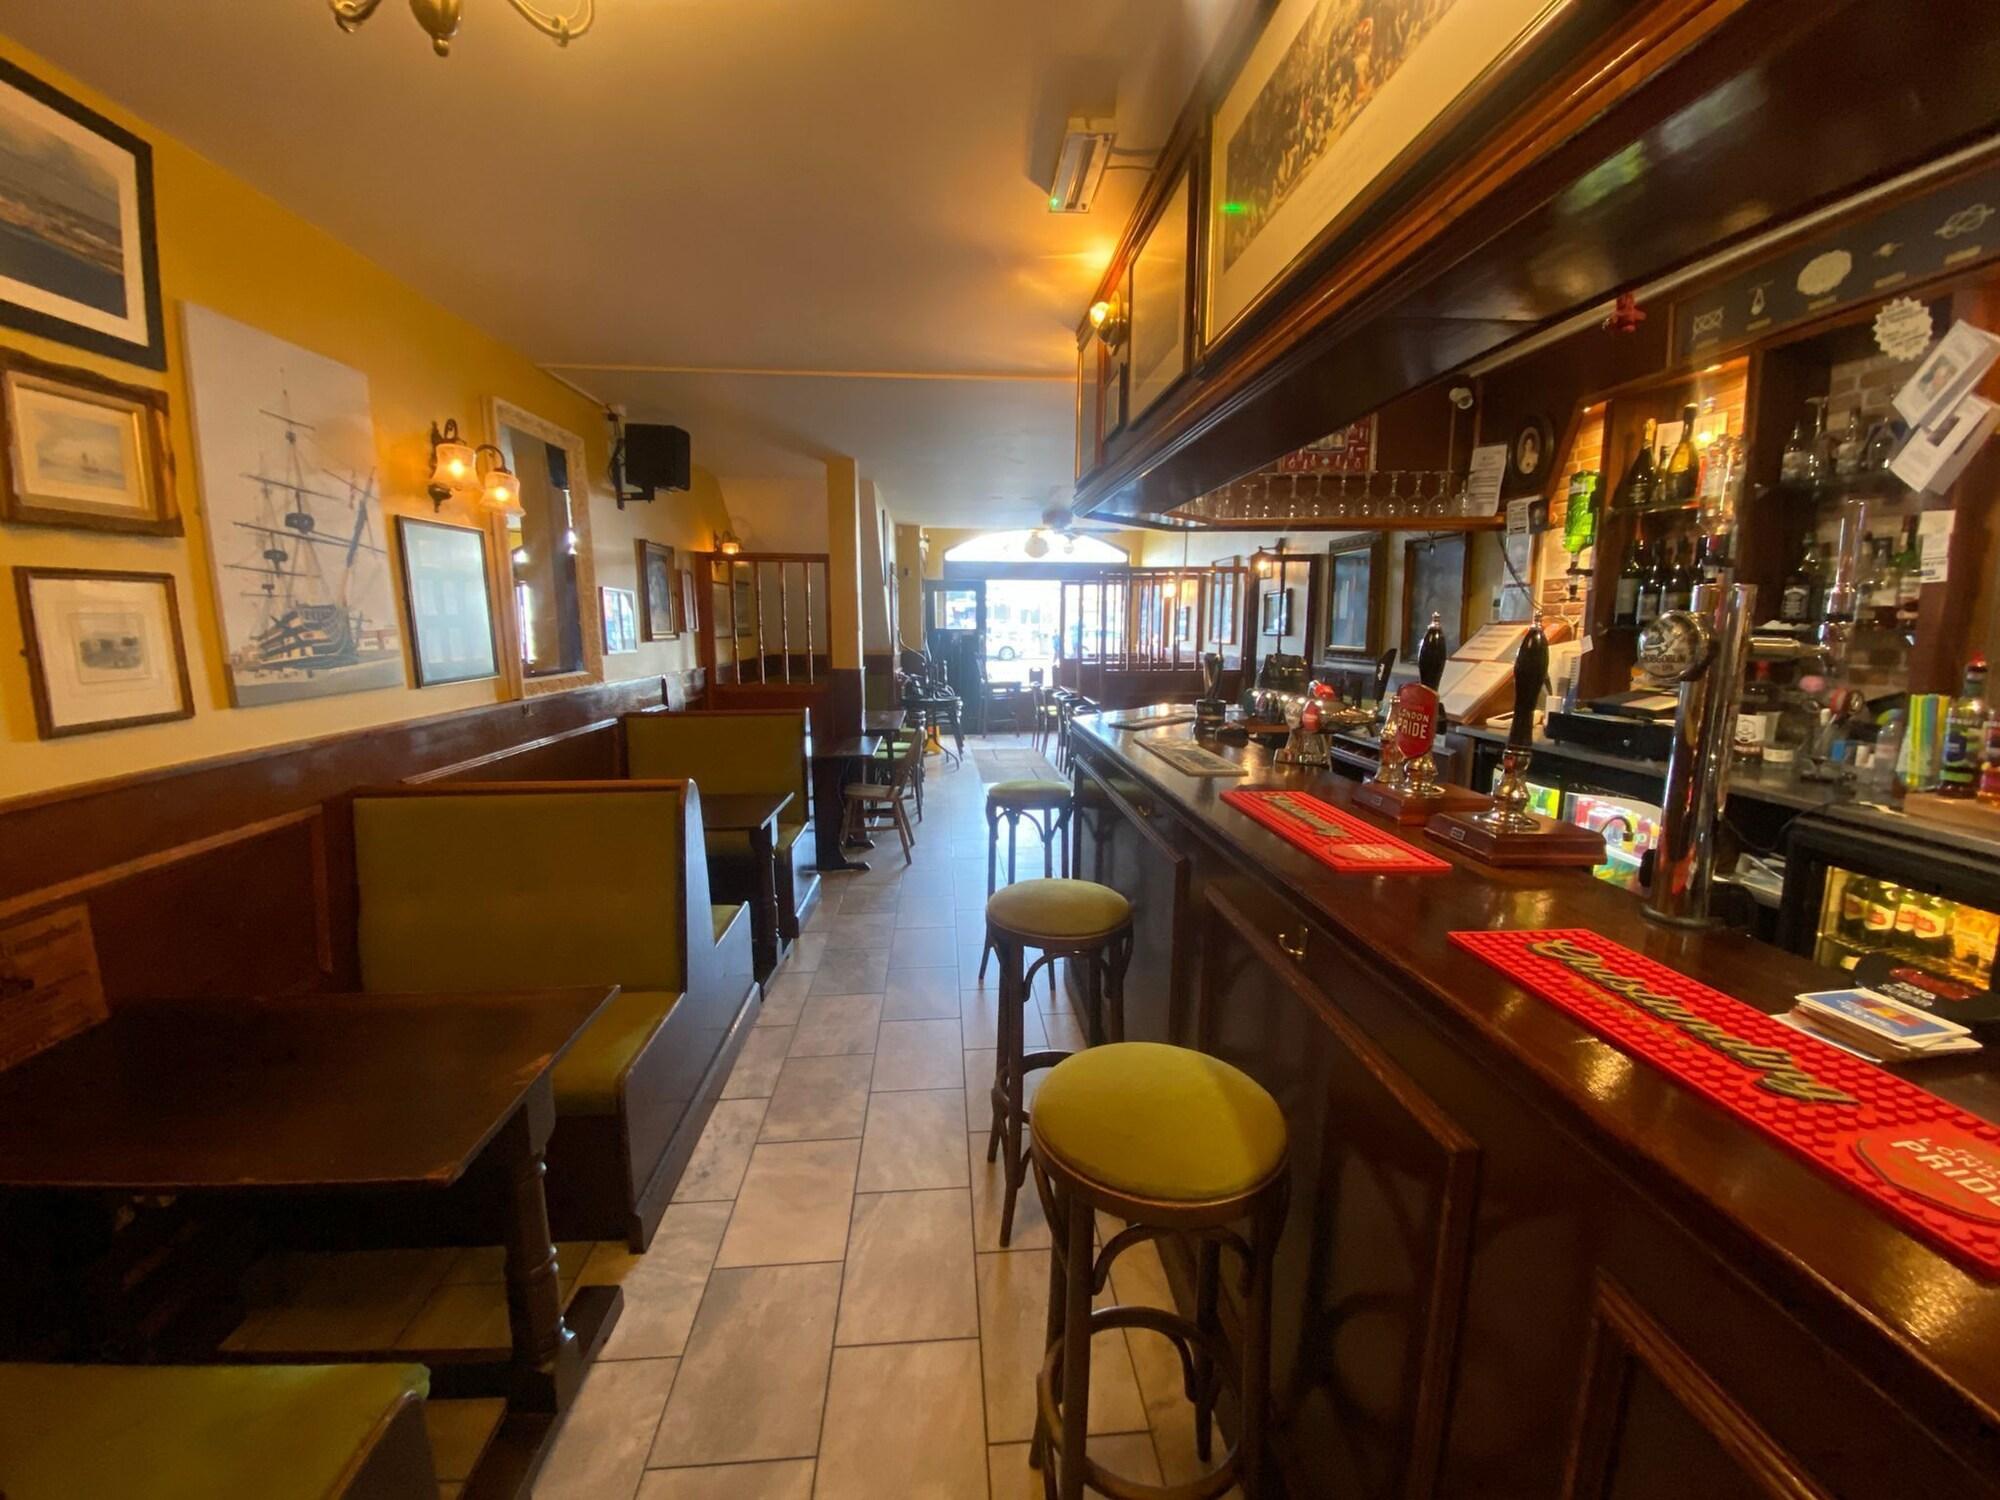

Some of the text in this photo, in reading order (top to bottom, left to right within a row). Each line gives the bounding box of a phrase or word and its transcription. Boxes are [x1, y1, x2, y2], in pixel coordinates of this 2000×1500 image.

[1397, 717, 1428, 740] PRIDE
[1398, 708, 1430, 723] LONDON
[1527, 938, 1862, 1106] Outstanding
[1917, 1137, 2000, 1185] LOND
